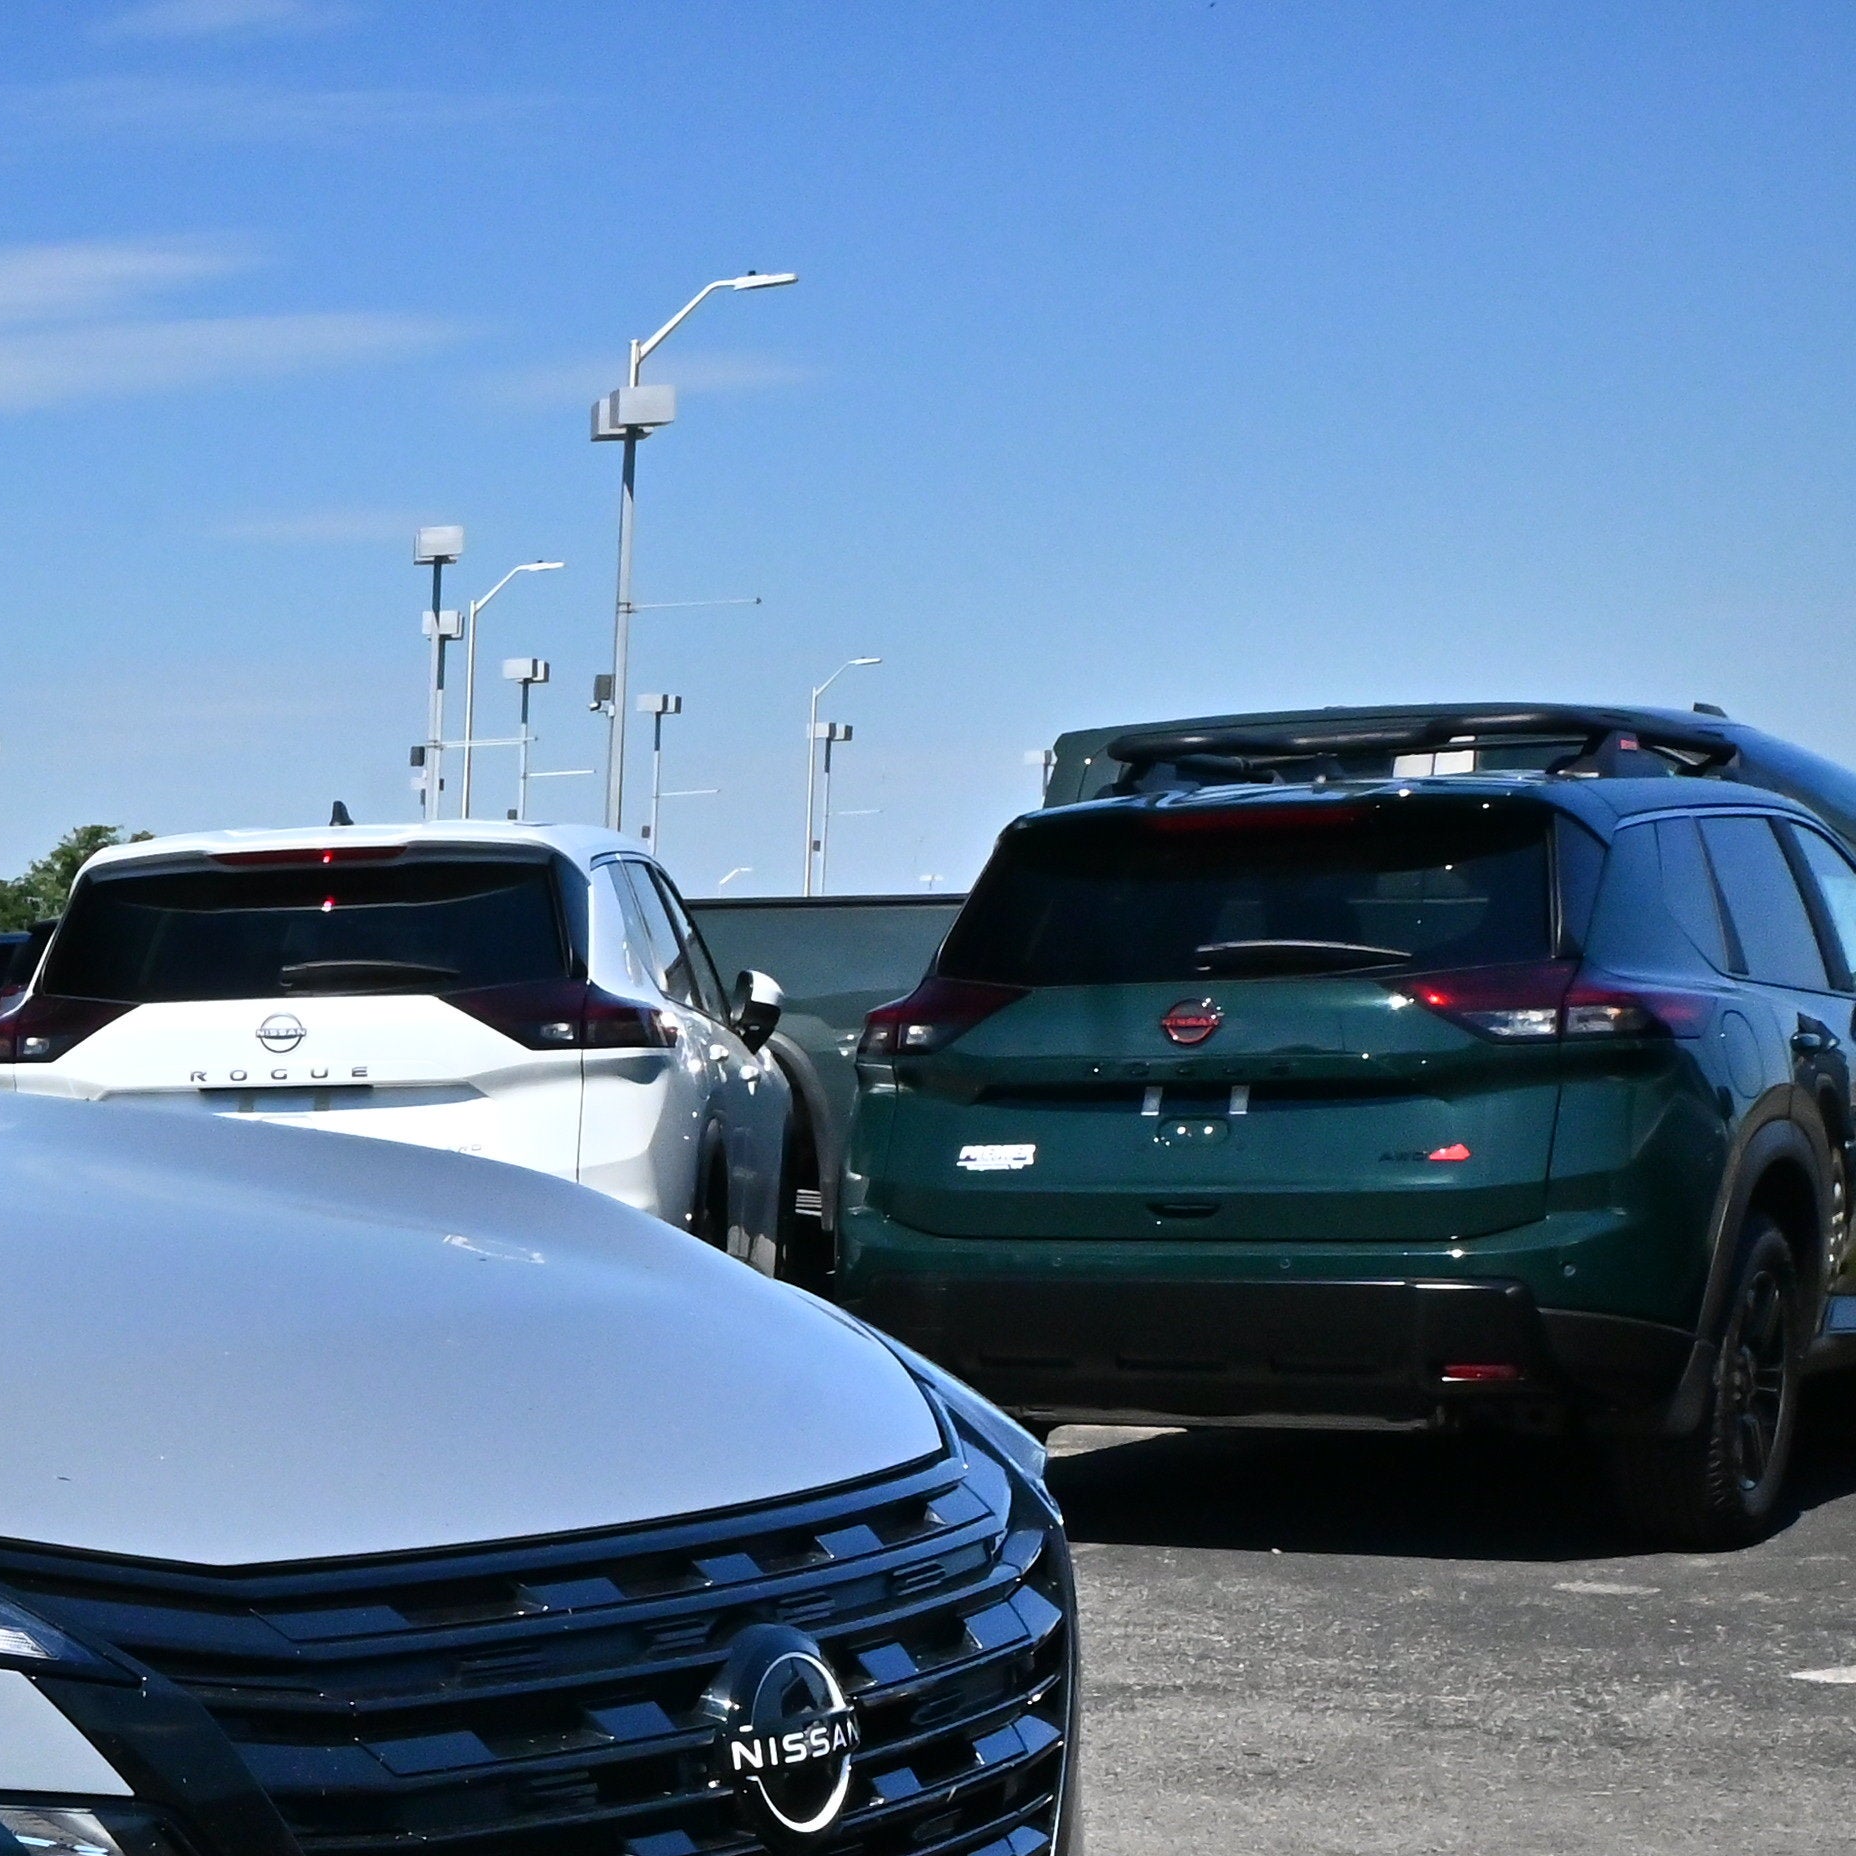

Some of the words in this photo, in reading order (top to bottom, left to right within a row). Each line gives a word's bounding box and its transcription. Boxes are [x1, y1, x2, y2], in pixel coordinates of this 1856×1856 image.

[256, 1028, 307, 1038] NISSAN
[190, 1066, 369, 1082] ROGUE
[731, 1715, 860, 1771] NISSAN
